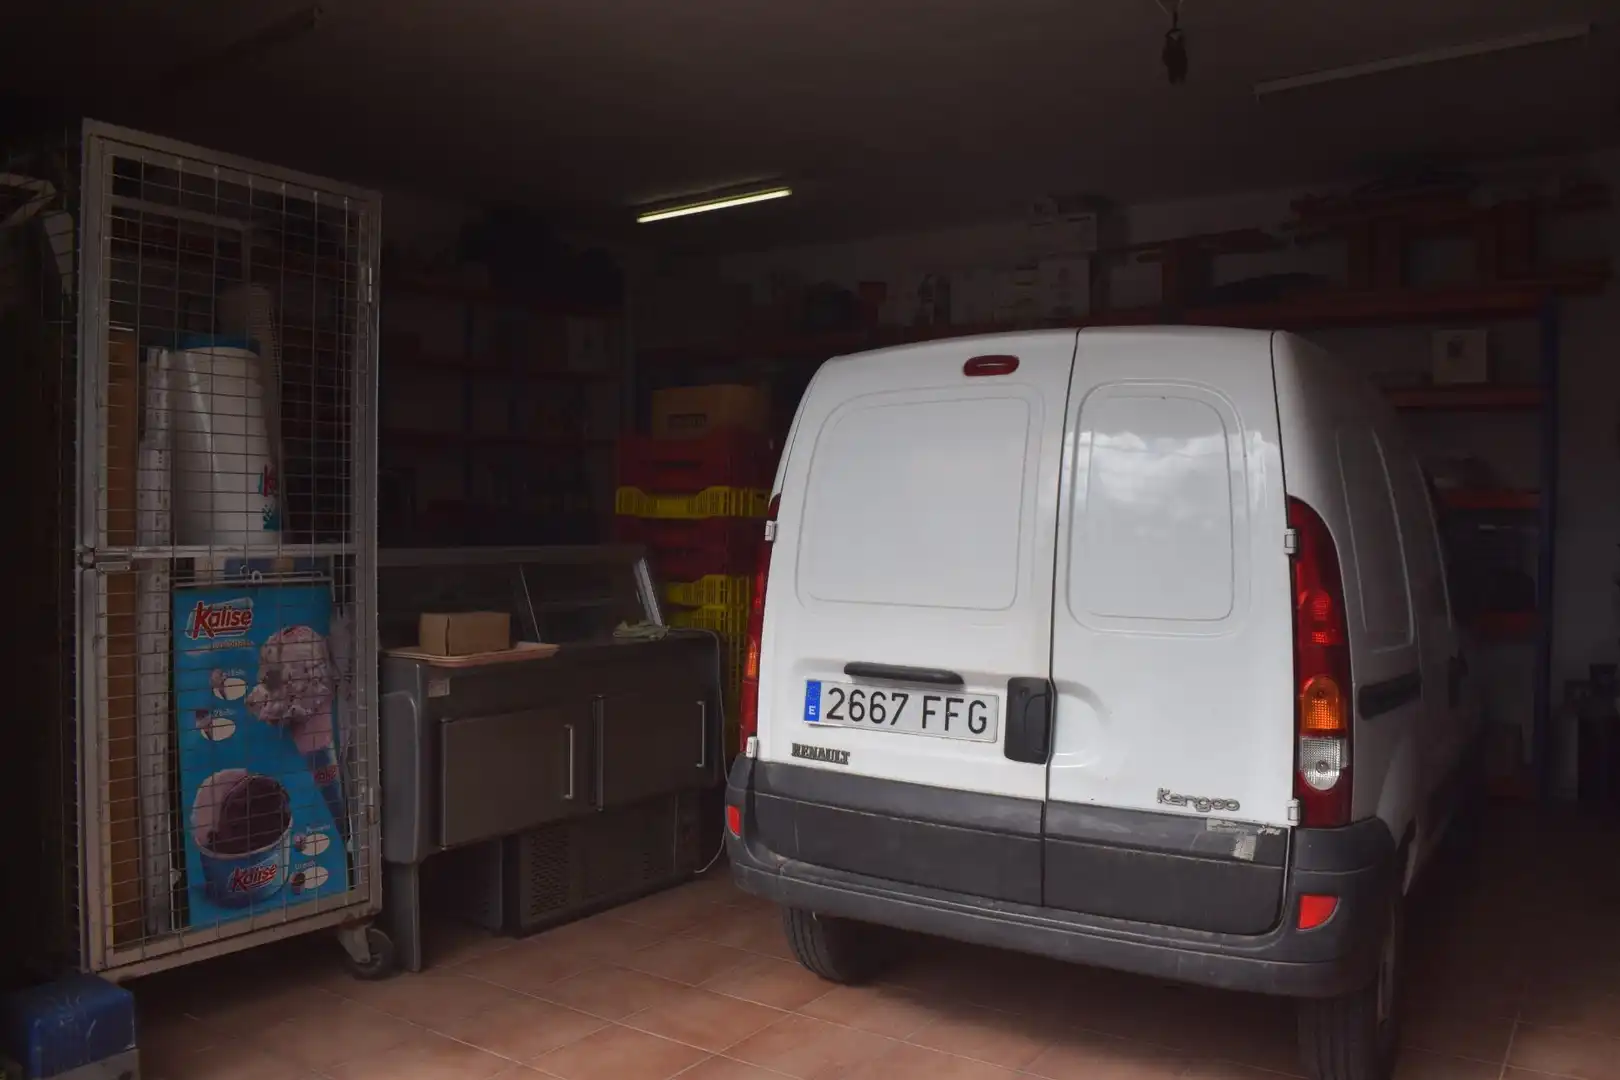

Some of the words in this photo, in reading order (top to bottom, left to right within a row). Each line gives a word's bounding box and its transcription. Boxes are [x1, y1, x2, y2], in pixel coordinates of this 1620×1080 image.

[191, 601, 253, 639] Kalise
[808, 705, 816, 716] E
[826, 687, 909, 726] 2667
[921, 695, 988, 735] FFG
[791, 742, 851, 765] RENAULT
[1156, 787, 1241, 813] Kangoo
[231, 863, 278, 893] Kalise
